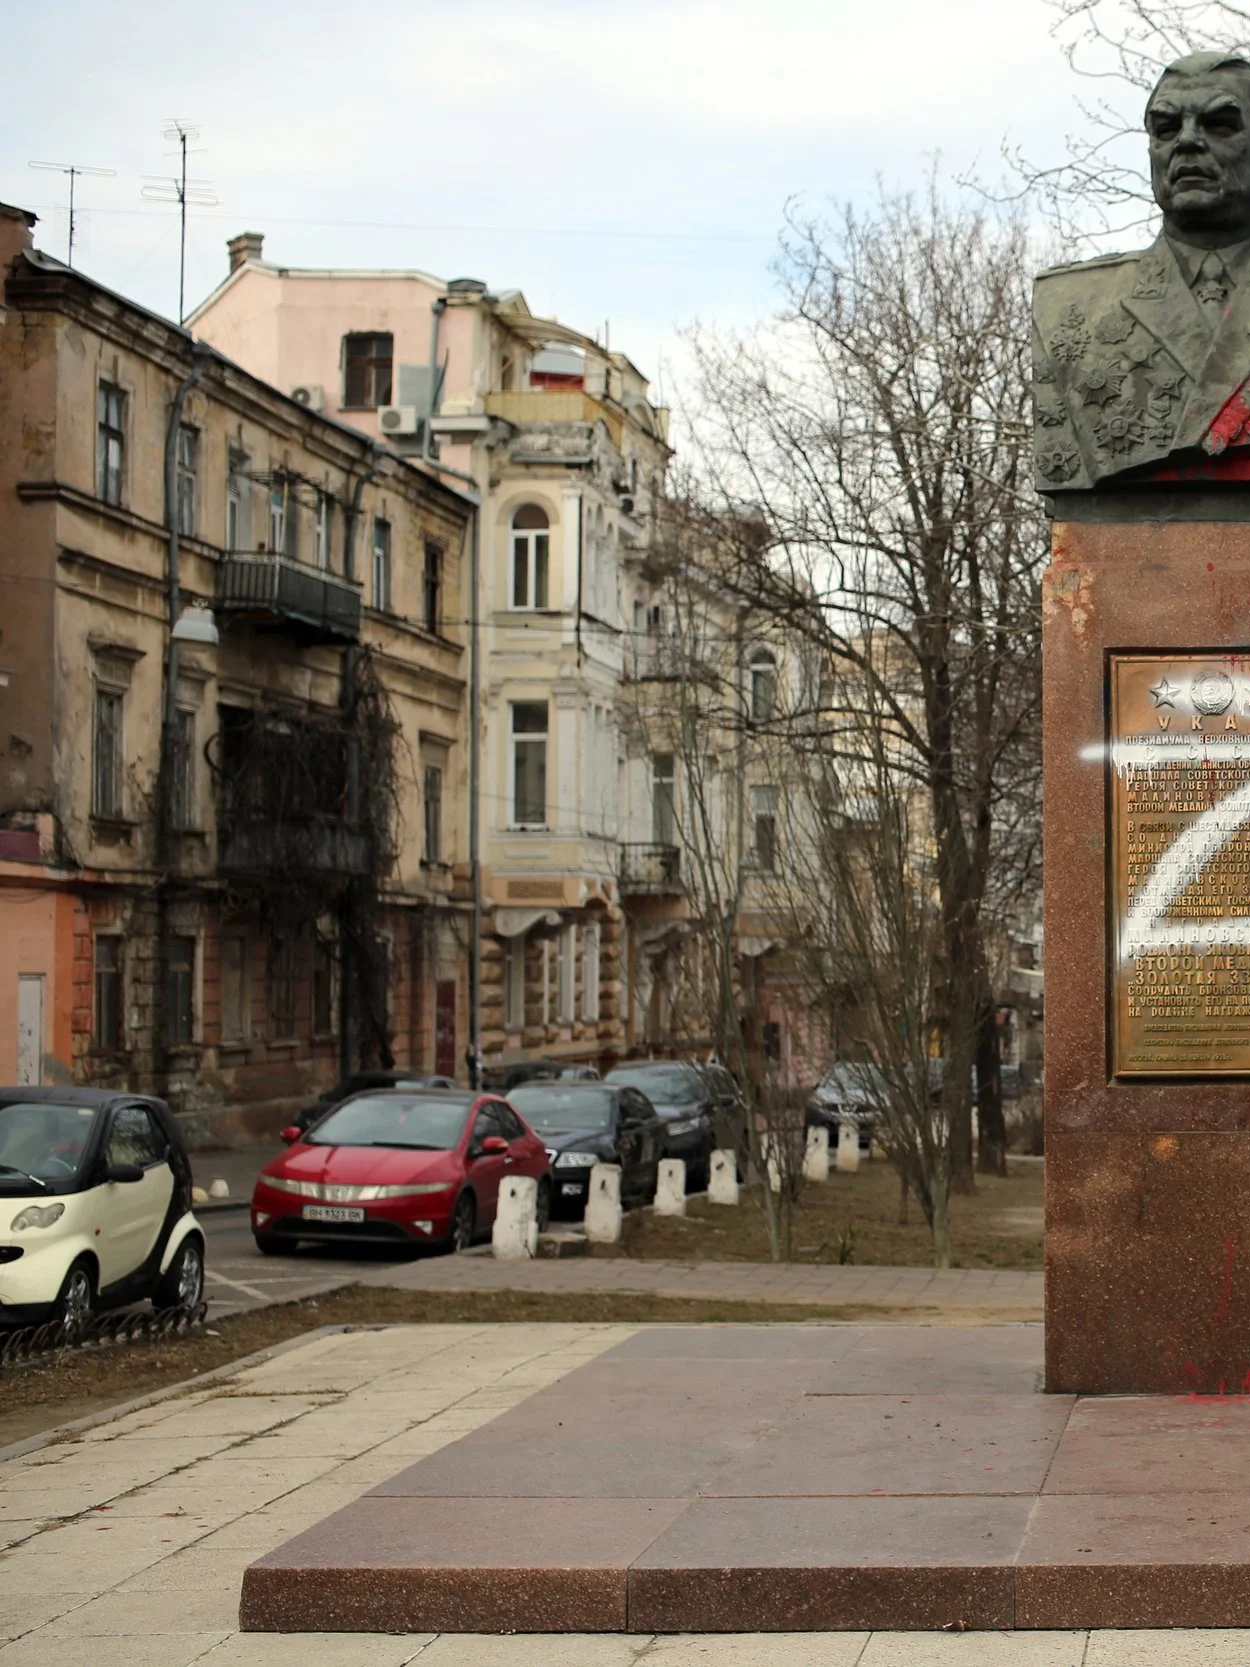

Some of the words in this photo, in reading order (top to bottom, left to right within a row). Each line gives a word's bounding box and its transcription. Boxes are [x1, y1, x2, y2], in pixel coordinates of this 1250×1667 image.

[1126, 735, 1190, 745] ПРЕЗИДИУМА
[1195, 759, 1236, 770] МИНИСТРА
[1127, 781, 1165, 791] ГЕРОЯ
[1174, 781, 1247, 791] СОВЕТСКОГО
[1127, 801, 1164, 812] ВТОРОЙ
[1127, 821, 1135, 832] В
[1140, 821, 1172, 832] СВЯЗИ
[1178, 821, 1185, 832] С
[1127, 832, 1146, 843] СО
[1160, 832, 1192, 843] ДНЯ
[1128, 843, 1193, 853] МИНИСТРА
[1127, 863, 1166, 874] ГЕРОЯ
[1177, 863, 1250, 873] СОВЕТСКОГО
[1127, 886, 1135, 896] И
[1143, 885, 1204, 896] ОТМЕЧАЯ
[1212, 885, 1233, 895] ЕГО
[1127, 896, 1157, 907] ПЕРЕД
[1163, 896, 1220, 906] СОВЕТСКИМ
[1127, 907, 1135, 917] И
[1142, 906, 1223, 917] ВООРУЖЕННЫМИ
[1135, 955, 1204, 970] ВТОРОЙ
[1128, 985, 1192, 995] СООРУДИТЬ
[1127, 996, 1135, 1006] И
[1140, 996, 1201, 1006] УСТАНОВИТЬ
[1205, 995, 1224, 1006] ЕГО
[1225, 995, 1238, 1005] НА
[1128, 1006, 1141, 1017] НА
[1151, 1006, 1195, 1017] РОДИНЕ
